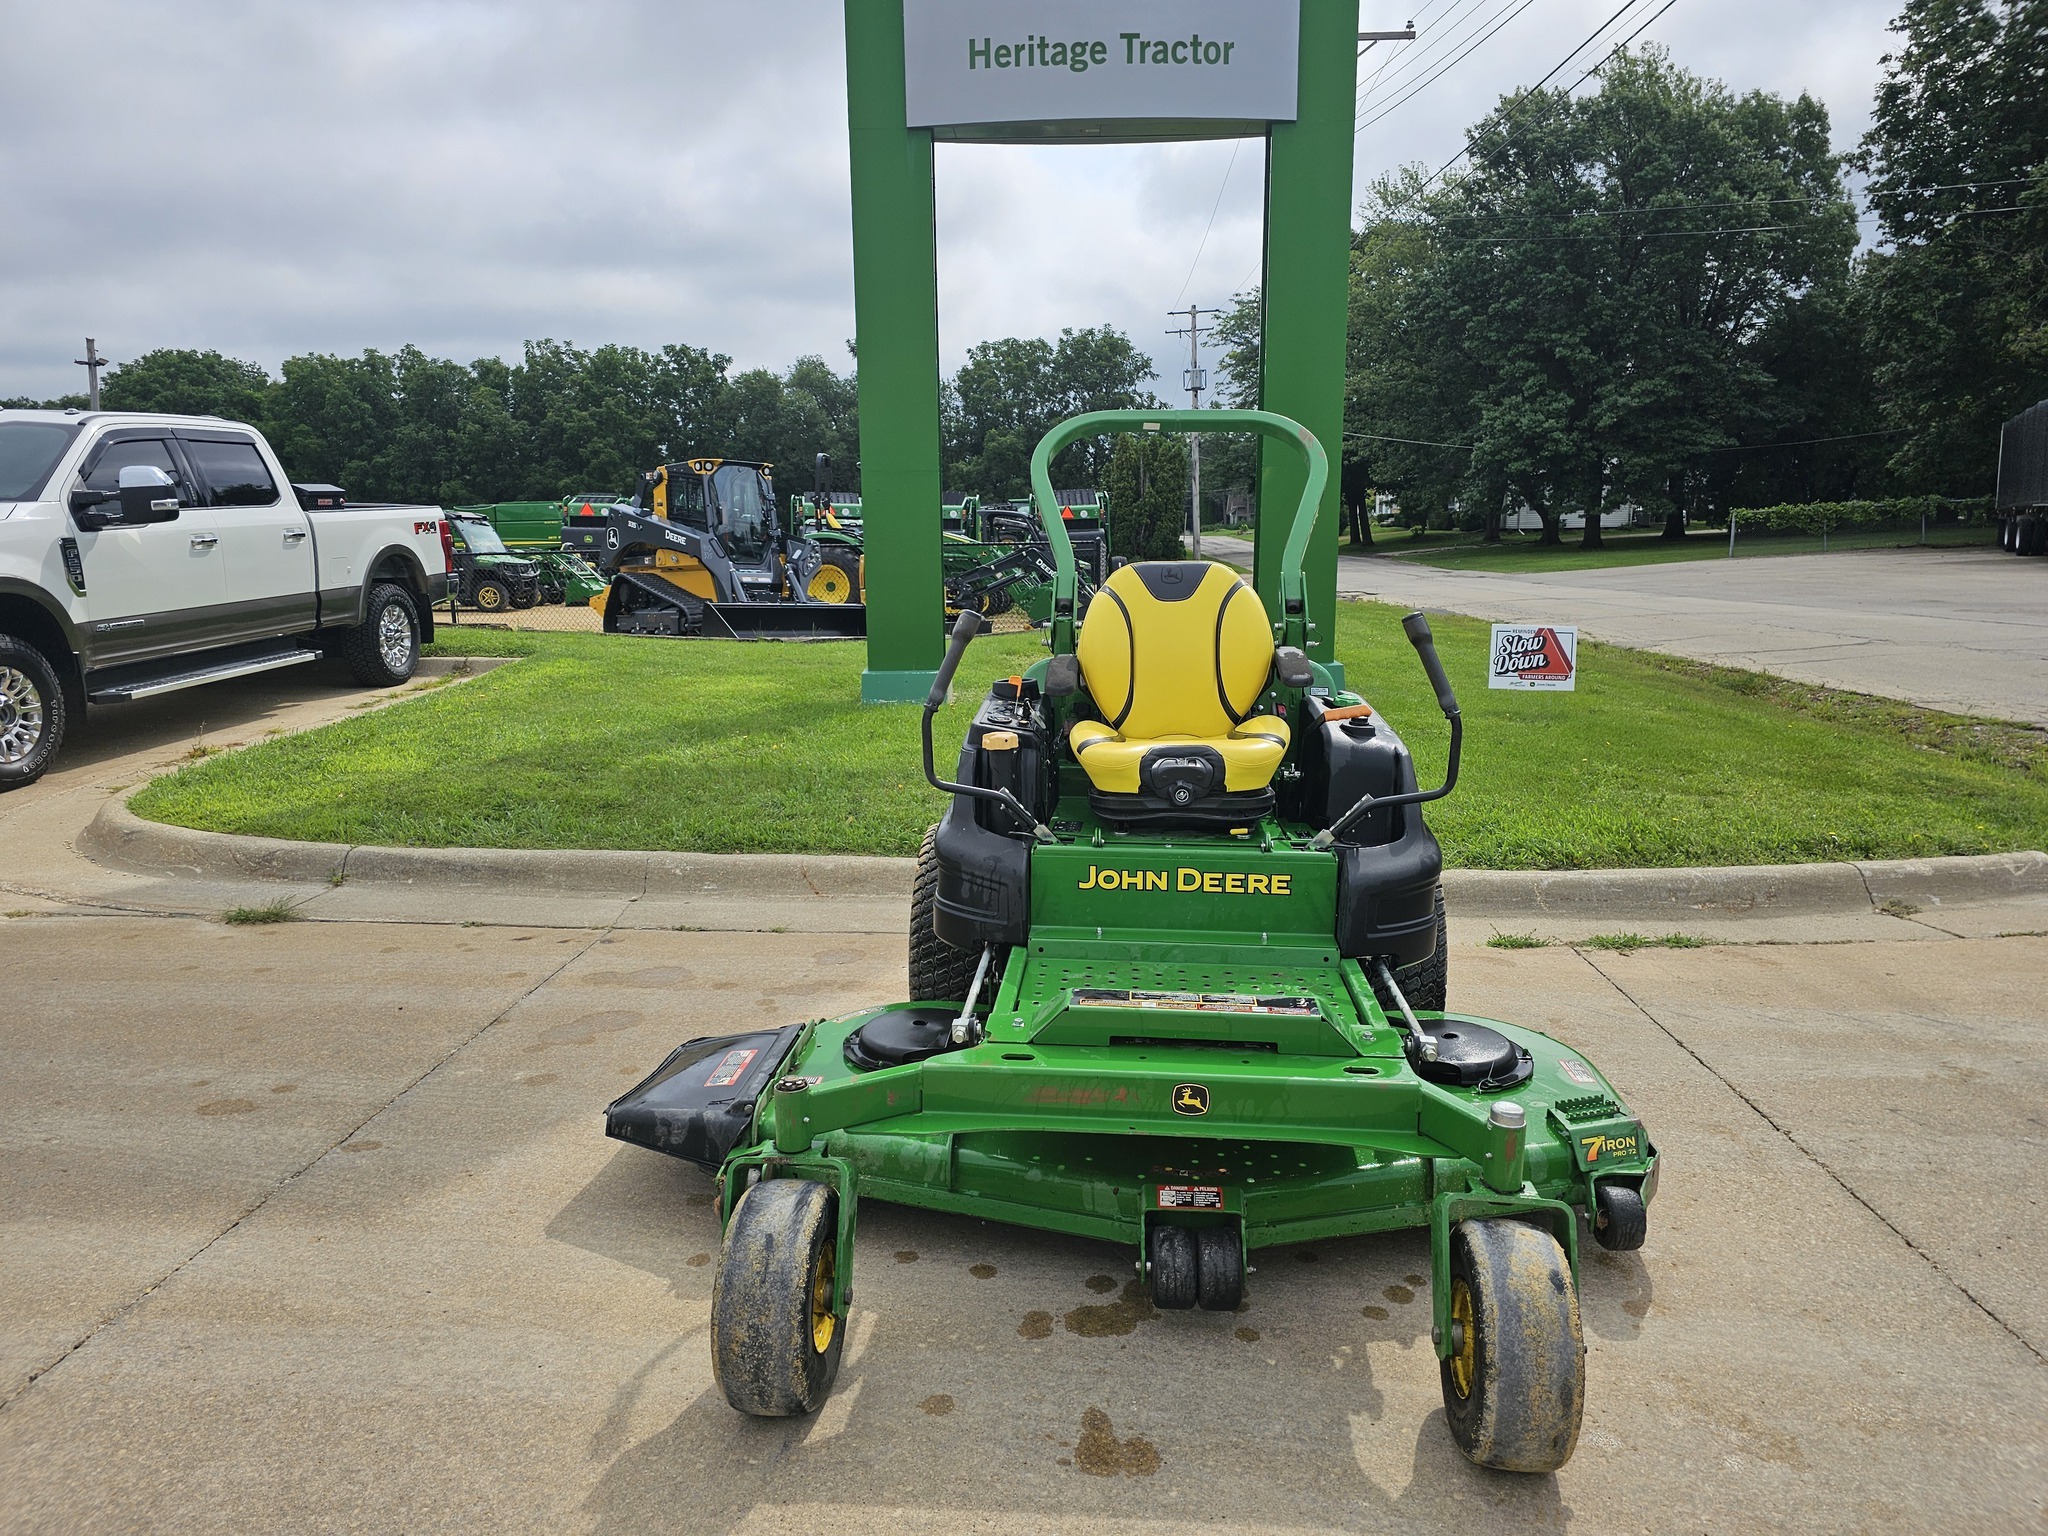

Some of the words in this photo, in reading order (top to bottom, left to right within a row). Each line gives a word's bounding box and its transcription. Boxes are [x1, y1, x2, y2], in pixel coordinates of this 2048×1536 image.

[968, 34, 1108, 73] Heritage
[1119, 32, 1235, 65] Tractor
[413, 521, 437, 535] FX4
[664, 529, 687, 546] DEERE
[1035, 557, 1058, 579] DEER
[1499, 634, 1546, 656] Slow
[1493, 653, 1548, 674] Down
[1078, 864, 1169, 892] JOHN
[1176, 867, 1293, 896] DEERE
[1613, 1150, 1627, 1158] PRO
